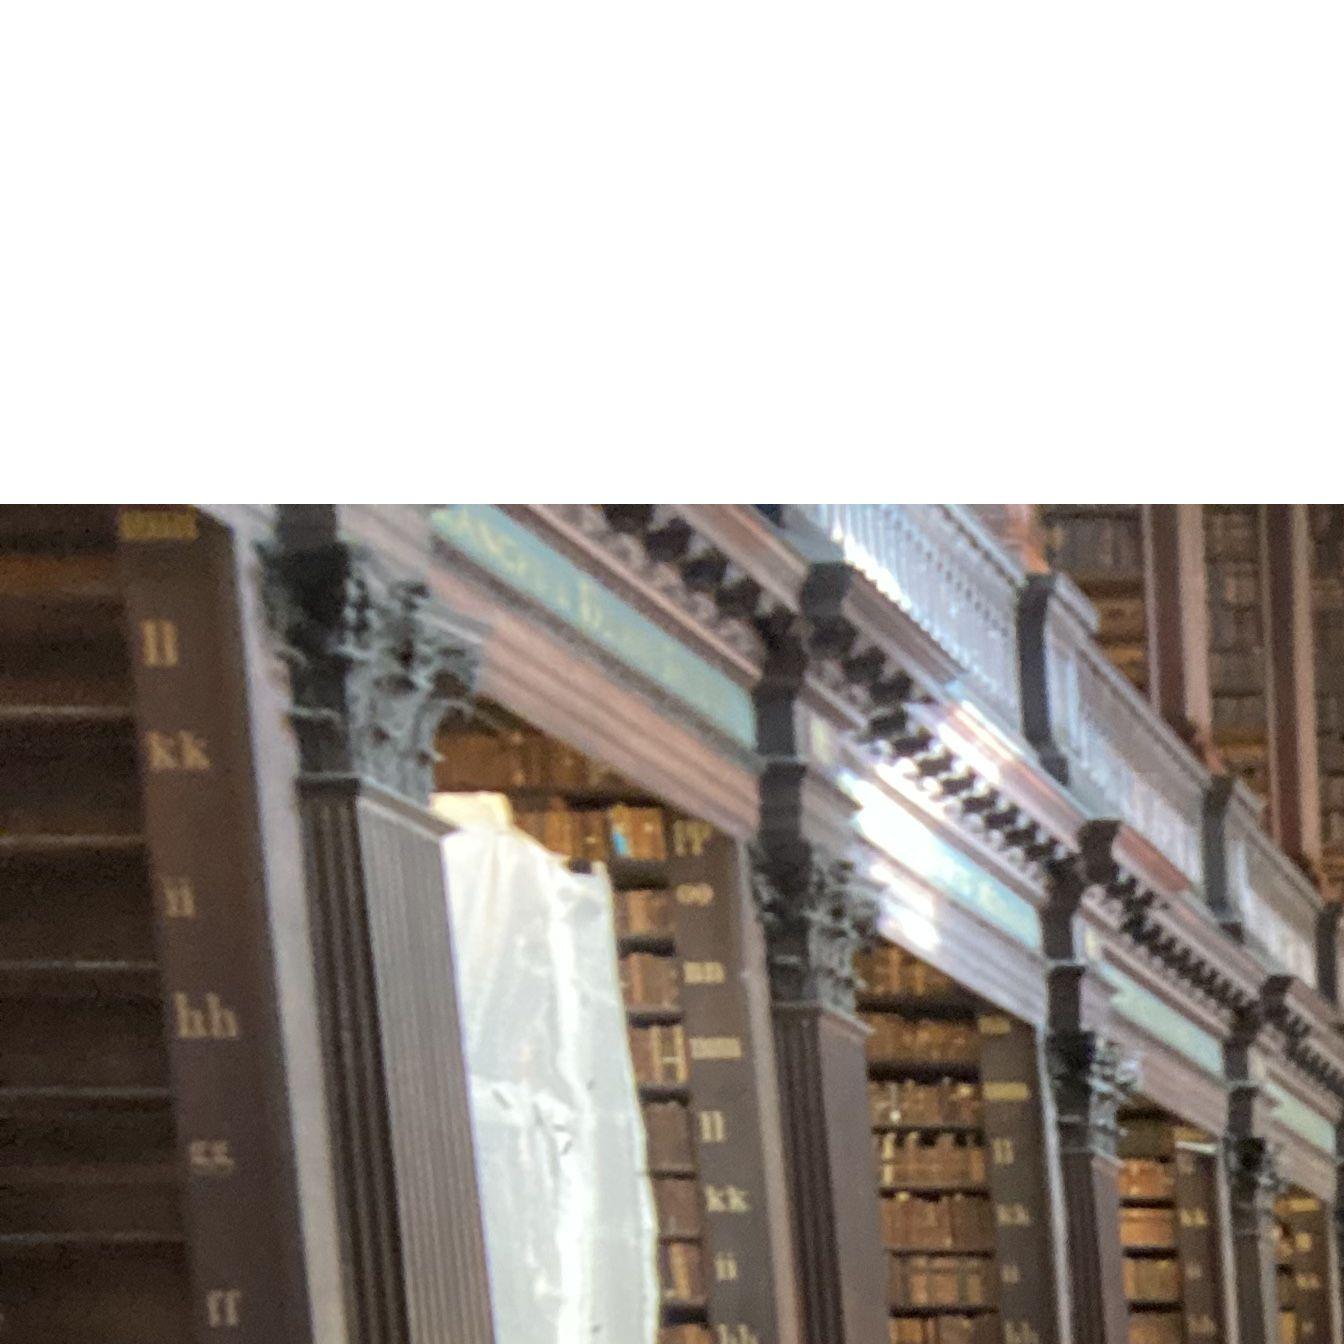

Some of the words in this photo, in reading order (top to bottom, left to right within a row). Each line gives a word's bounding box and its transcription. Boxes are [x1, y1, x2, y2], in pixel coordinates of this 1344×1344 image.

[142, 619, 179, 667] ll
[145, 730, 211, 771] kk
[174, 992, 238, 1038] hh
[705, 1183, 750, 1212] kk
[206, 1288, 241, 1327] ff
